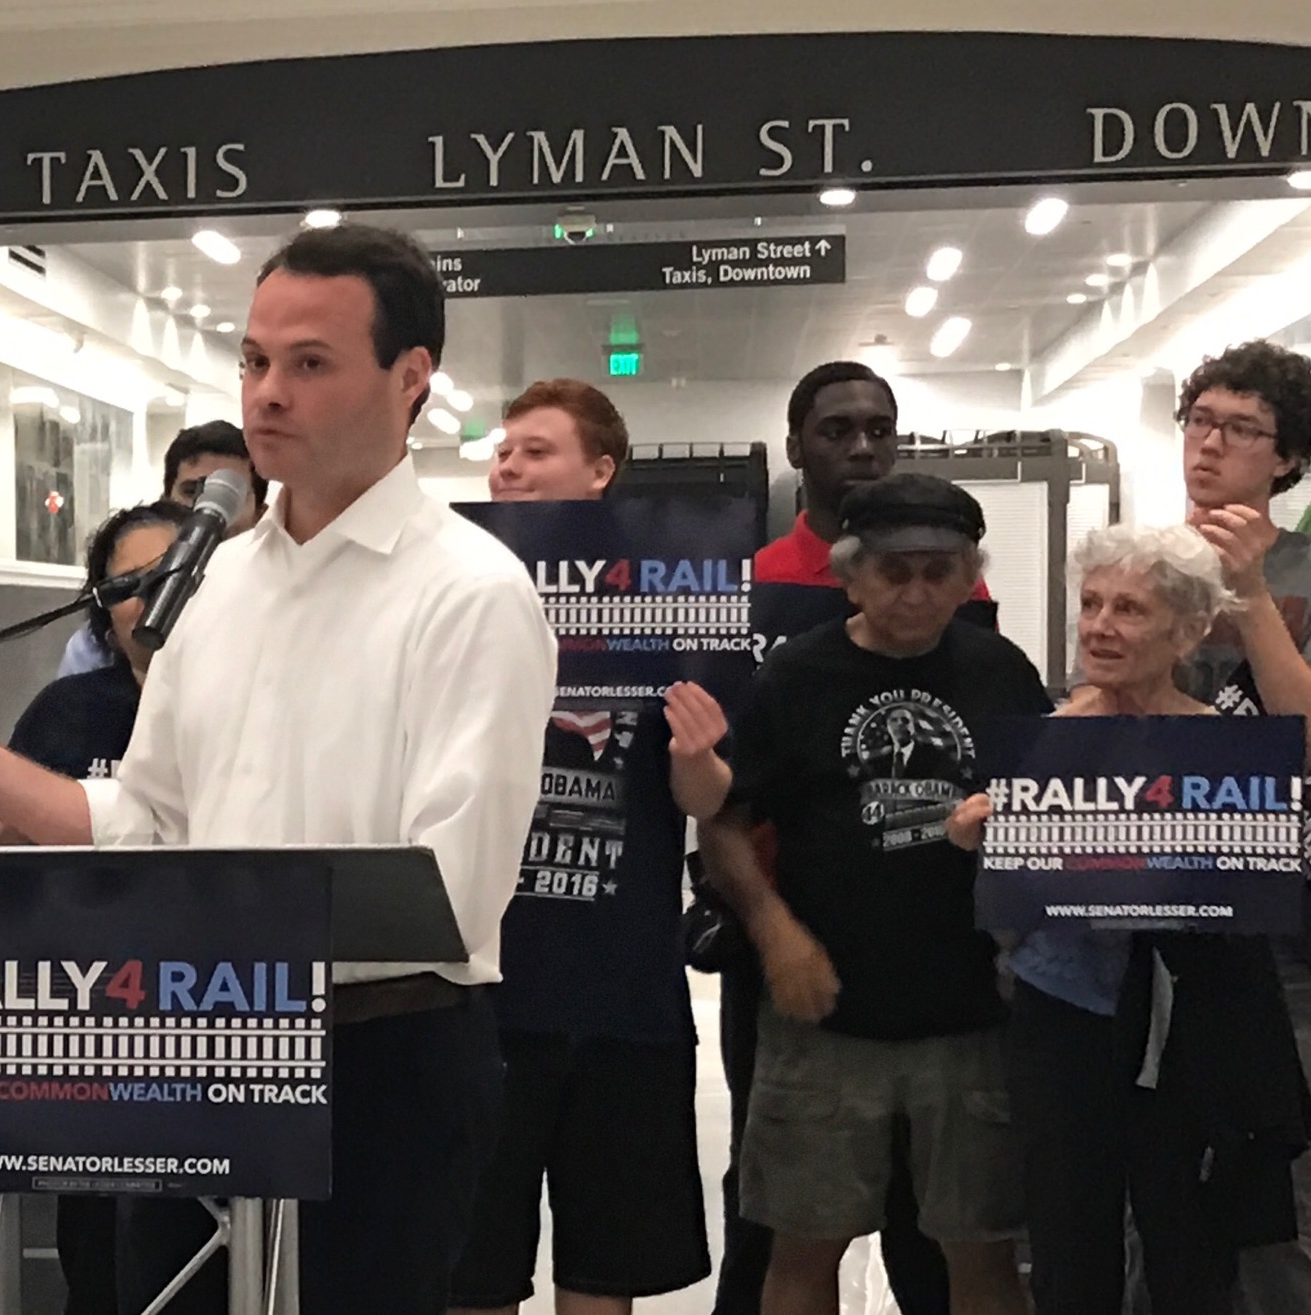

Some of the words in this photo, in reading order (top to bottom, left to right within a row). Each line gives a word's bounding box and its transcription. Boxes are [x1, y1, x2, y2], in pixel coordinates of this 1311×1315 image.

[428, 123, 703, 189] LYMAN
[759, 117, 874, 177] ST.
[26, 142, 249, 205] TAXIS
[431, 254, 462, 272] ins
[692, 244, 751, 265] Lyman
[757, 240, 812, 259] Street
[442, 275, 481, 292] ator
[662, 266, 713, 285] Taxis,
[719, 263, 811, 282] Downtown
[536, 559, 632, 594] LLY4
[640, 558, 752, 593] RAIL!
[672, 637, 698, 651] ON
[702, 637, 751, 652] TRACK
[869, 688, 905, 707] YOU
[541, 772, 616, 801] OBAMA
[986, 775, 1174, 812] #RALLY4
[1182, 775, 1302, 812] RAIL!
[528, 831, 624, 869] DENT
[983, 857, 1023, 871] KEEP
[1024, 857, 1063, 871] OUR
[1216, 856, 1244, 870] ON
[1247, 857, 1302, 872] TRACK
[534, 870, 600, 898] 2016
[1045, 904, 1234, 919] WWW.SENATORLESSER.COM
[158, 960, 327, 1014] RAIL!
[207, 1083, 246, 1104] ON
[250, 1084, 328, 1105] TRACK
